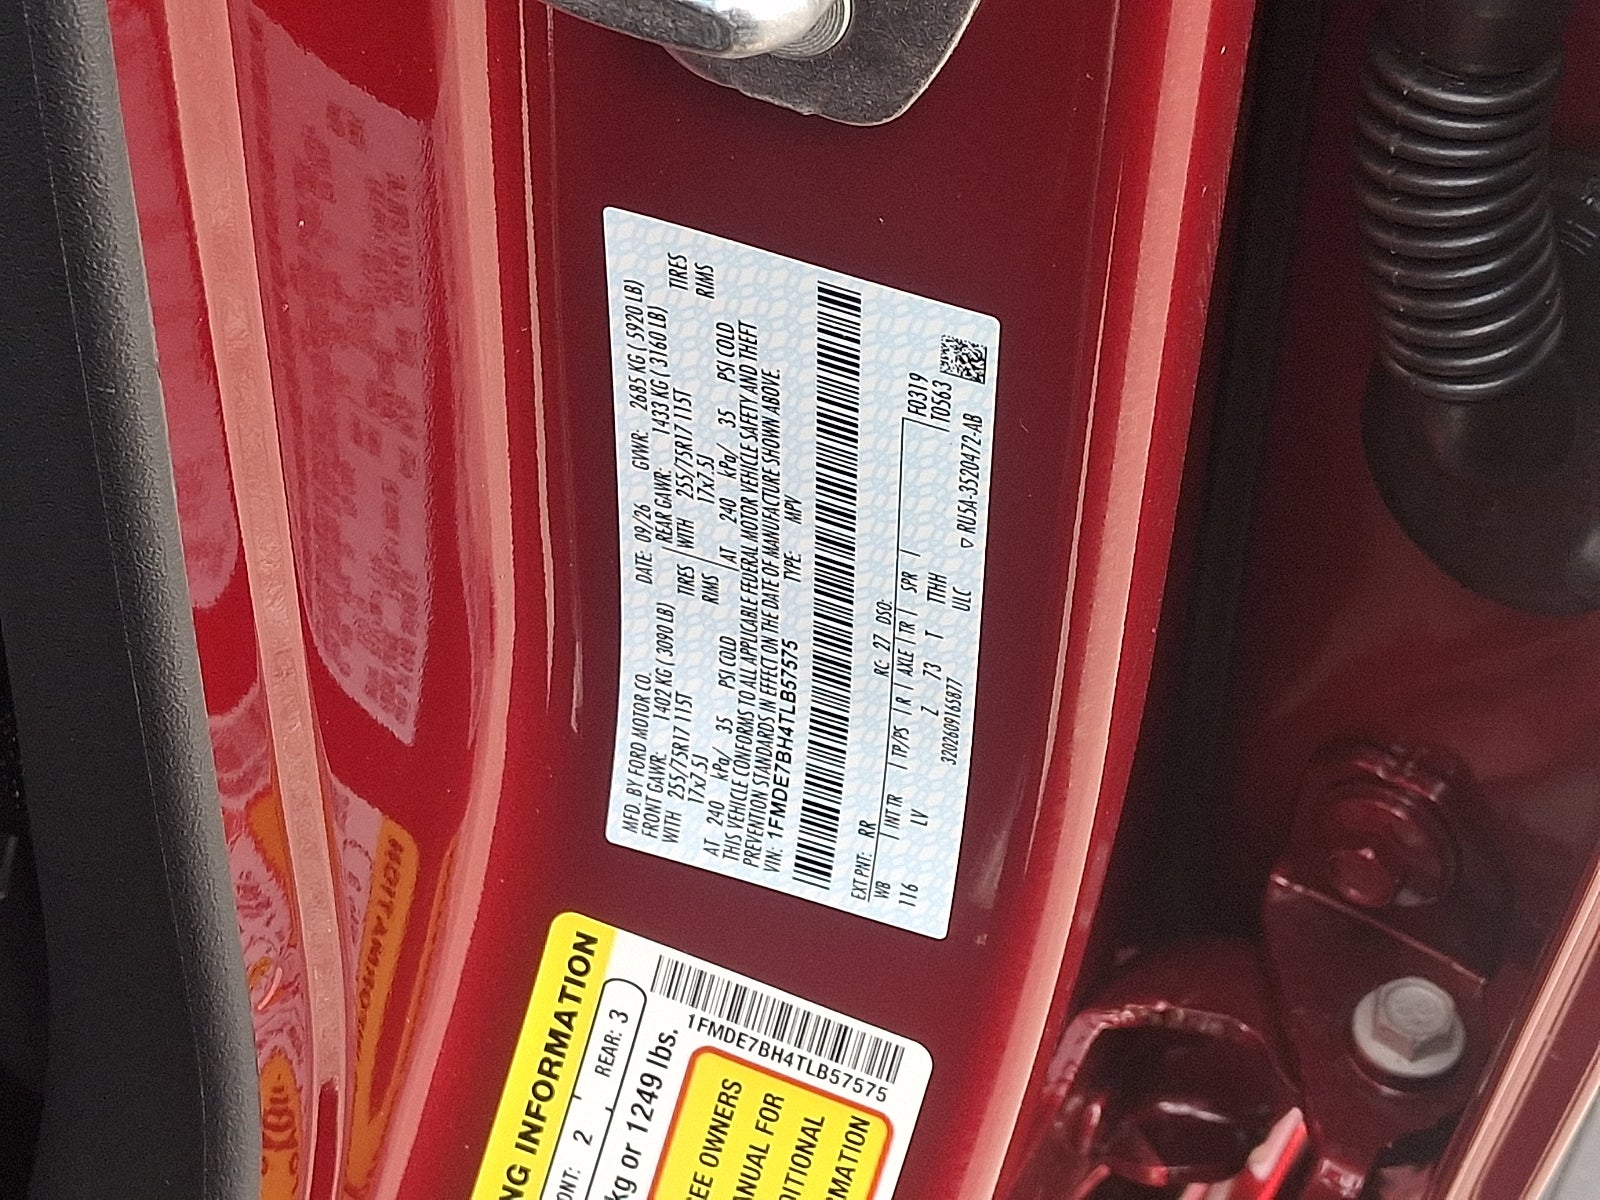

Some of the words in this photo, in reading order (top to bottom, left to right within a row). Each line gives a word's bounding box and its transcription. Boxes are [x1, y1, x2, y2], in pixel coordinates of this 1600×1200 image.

[666, 251, 689, 291] TIRES
[693, 261, 715, 300] RIMS
[622, 278, 646, 304] LB)
[624, 304, 646, 343] 5920
[646, 304, 669, 330] LB)
[647, 330, 669, 369] 3160
[715, 321, 736, 359] COLD
[739, 319, 758, 362] THEFT
[626, 352, 647, 375] KG
[715, 359, 736, 384] PSI
[739, 363, 759, 396] AND
[627, 374, 649, 412] 2685
[649, 378, 670, 400] KG
[672, 386, 693, 422] 115T
[760, 368, 781, 417] ABOVE.
[906, 371, 929, 418] F0319
[929, 379, 953, 424] T0563
[650, 400, 671, 436] 1433
[717, 407, 737, 429] 35
[739, 393, 759, 443] SAFETY
[630, 429, 650, 471] GVWR:
[760, 415, 781, 467] SHOWN
[673, 422, 696, 501] 255/75R17
[695, 452, 716, 505] 17x7.5J
[715, 442, 740, 480] kPa/
[739, 441, 760, 495] VEHICLE
[955, 412, 983, 535] RU5A-3520472-AB
[652, 467, 673, 510] GAWR:
[632, 502, 655, 544] 09/26
[718, 496, 738, 525] 240
[739, 495, 759, 544] MOTOR
[761, 465, 781, 560] MANUFACTURE
[783, 493, 803, 526] MPV
[654, 510, 674, 545] REAR
[675, 516, 695, 550] WITH
[634, 550, 654, 586] DATE:
[718, 544, 738, 565] AT
[739, 544, 759, 597] FEDERAL
[760, 558, 780, 578] OF
[782, 550, 802, 584] TYPE:
[676, 562, 696, 598] TIRES
[700, 572, 720, 606] RIMS
[760, 576, 780, 611] DATE
[899, 570, 919, 595] SPR
[926, 571, 948, 606] TTHH
[655, 601, 677, 624] LB)
[951, 585, 973, 613] ULC
[739, 595, 759, 667] APPLICABLE
[760, 609, 780, 635] THE
[897, 620, 916, 636] TR
[924, 629, 945, 640] T
[655, 623, 675, 658] 3090
[718, 635, 738, 668] COLD
[760, 634, 779, 655] ON
[871, 632, 892, 653] 27
[654, 666, 673, 688] KG
[717, 668, 737, 691] PSI
[738, 667, 758, 691] ALL
[758, 654, 779, 698] EFFECT
[895, 647, 915, 678] AXLE
[921, 661, 943, 682] 73
[633, 672, 653, 692] CO.
[737, 689, 757, 708] TO
[631, 693, 651, 741] MOTOR
[652, 687, 673, 722] 1402
[673, 689, 693, 723] 115T
[758, 697, 777, 715] IN
[894, 695, 912, 707] R
[919, 704, 940, 717] Z
[714, 714, 734, 735] 35
[766, 637, 799, 840] 1FMDE7BH4TLB57575
[939, 676, 964, 766] 3202609165877
[731, 708, 756, 778] CONFORMS
[751, 713, 776, 789] STANDARDS
[890, 724, 911, 759] TP/PS
[627, 741, 648, 778] FORD
[645, 751, 668, 794] GAWR:
[666, 724, 691, 801] 255/75R17
[709, 745, 734, 782] kPa/
[625, 777, 644, 798] BY
[686, 753, 710, 805] 17x7.5J
[640, 794, 663, 840] FRONT
[705, 799, 726, 828] 240
[726, 778, 750, 830] VEHICLE
[885, 793, 904, 808] TR
[909, 807, 929, 827] LV
[621, 802, 642, 835] MFD.
[661, 809, 683, 844] WITH
[741, 788, 769, 869] PREVENTION
[857, 819, 878, 840] RR
[883, 807, 902, 830] INT
[702, 837, 721, 858] AT
[722, 831, 743, 862] THIS
[762, 846, 784, 873] VIN:
[853, 851, 873, 879] PNT:
[850, 877, 869, 901] EXT
[873, 880, 892, 900] WB
[897, 882, 919, 908] 116
[608, 1008, 629, 1024] 3
[514, 930, 600, 1156] INFORMATION
[594, 1029, 623, 1078] REAR:
[645, 1029, 679, 1069] lbs.
[688, 1013, 890, 1103] 1FMDE7BH4TLB57575
[626, 1072, 664, 1133] 1249
[754, 1092, 785, 1136] FOR
[572, 1129, 594, 1146] 2
[698, 1078, 743, 1168] OWNERS
[620, 1142, 642, 1170] or
[825, 1115, 871, 1200] MATION
[685, 1171, 714, 1200] EE
